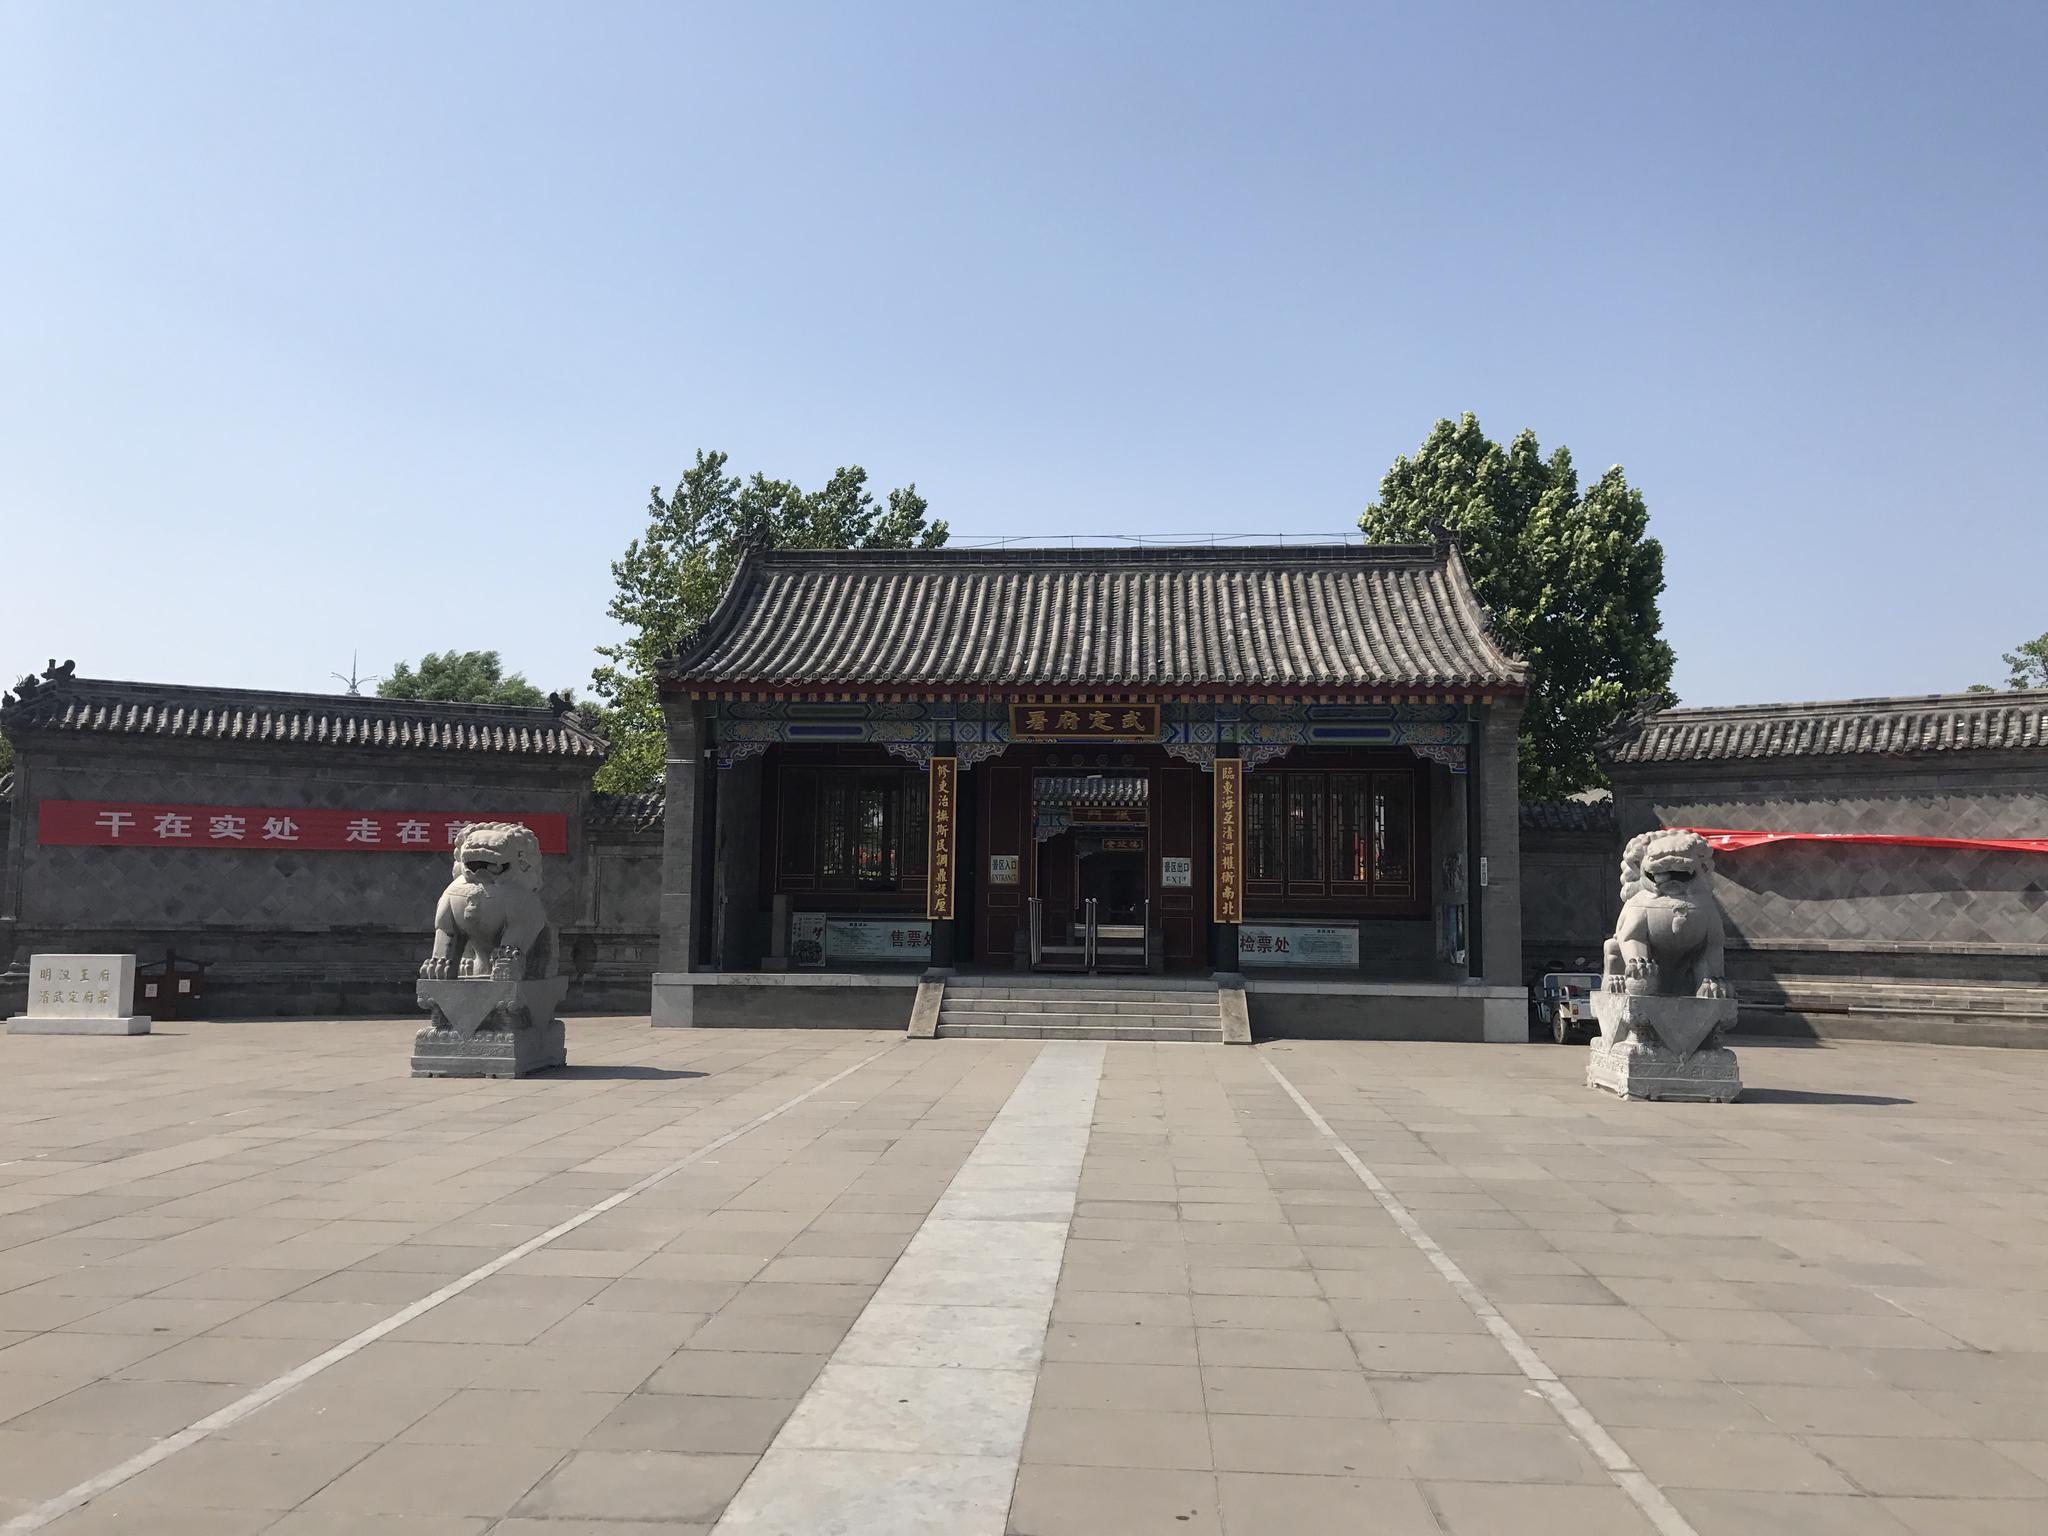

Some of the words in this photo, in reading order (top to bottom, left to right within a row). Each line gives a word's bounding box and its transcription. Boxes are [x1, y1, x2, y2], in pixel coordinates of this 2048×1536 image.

[95, 811, 300, 841] 干在实处
[991, 859, 1017, 871] 景区入口
[1164, 861, 1190, 873] 景区出口
[1166, 875, 1187, 884] EXIT
[1239, 935, 1290, 954] 检票处
